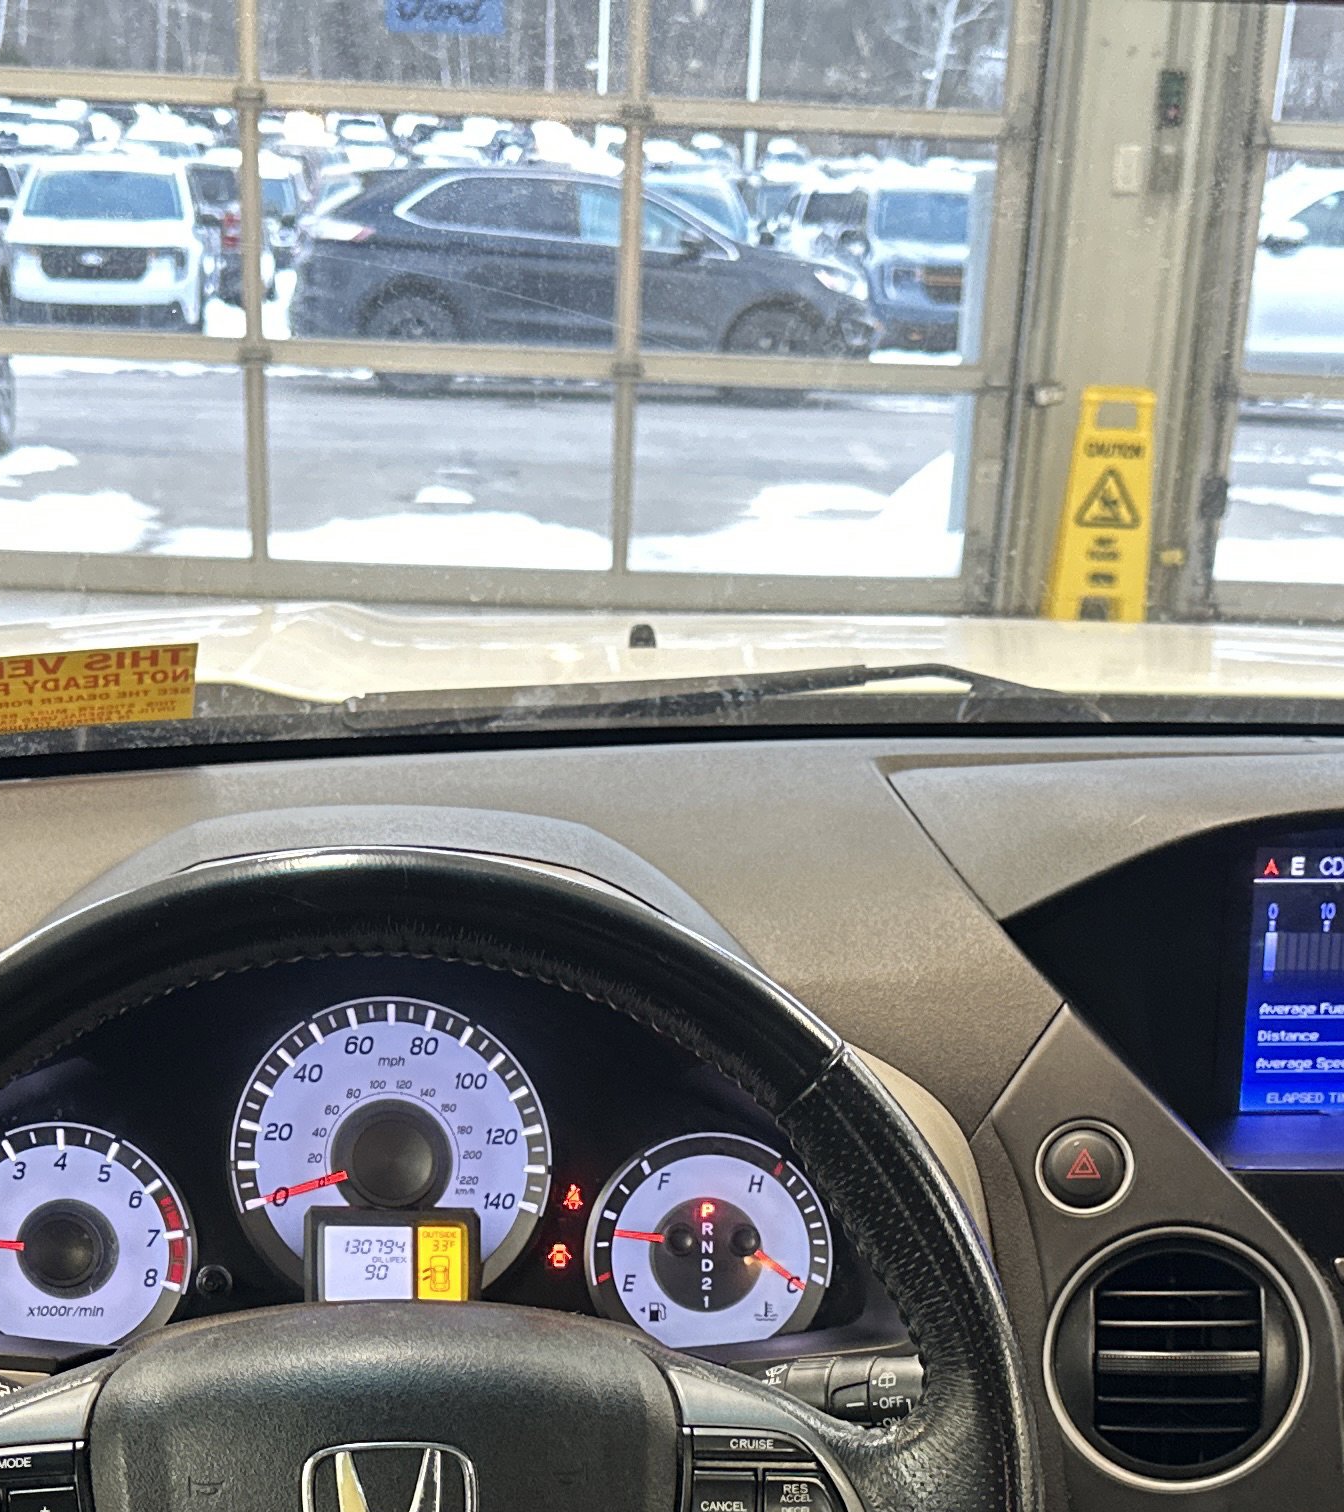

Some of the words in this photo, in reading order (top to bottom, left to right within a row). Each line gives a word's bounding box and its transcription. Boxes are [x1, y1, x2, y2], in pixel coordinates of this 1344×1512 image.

[1268, 902, 1279, 920] 0
[1320, 902, 1337, 920] 10
[1259, 1002, 1317, 1017] Average
[1257, 1029, 1319, 1042] Distance
[344, 1036, 374, 1055] 60
[410, 1037, 439, 1055] 80
[378, 1056, 405, 1067] mph
[1256, 1057, 1313, 1071] Average
[293, 1064, 323, 1083] 40
[455, 1073, 487, 1090] 100
[369, 1080, 386, 1090] 100
[396, 1080, 412, 1090] 120
[346, 1088, 361, 1099] 80
[420, 1087, 436, 1098] 140
[1266, 1091, 1324, 1104] ELAPSED
[324, 1105, 340, 1115] 60
[264, 1123, 293, 1141] 20
[311, 1128, 327, 1138] 40
[485, 1128, 518, 1145] 120
[53, 1152, 67, 1171] 4
[307, 1153, 321, 1163] 20
[462, 1151, 482, 1160] 200
[12, 1161, 26, 1180] 3
[97, 1164, 112, 1182] 5
[459, 1176, 479, 1185] 220
[657, 1172, 671, 1191] F
[748, 1175, 765, 1192] H
[128, 1190, 143, 1208] 6
[273, 1187, 289, 1207] 0
[483, 1193, 515, 1210] 140
[700, 1202, 715, 1217] P
[701, 1223, 714, 1235] R
[146, 1229, 160, 1247] 7
[701, 1241, 714, 1254] N
[701, 1259, 714, 1272] D
[143, 1268, 158, 1287] 8
[364, 1265, 389, 1280] 90
[622, 1274, 636, 1292] E
[786, 1276, 800, 1293] C
[701, 1278, 712, 1290] 2
[703, 1296, 710, 1308] 1
[27, 1304, 104, 1318] x1000r/min
[878, 1396, 904, 1409] OFF
[730, 1438, 774, 1449] CRUISE
[783, 1484, 809, 1494] RES
[780, 1493, 812, 1503] ACCEL
[700, 1501, 747, 1512] CANCEL
